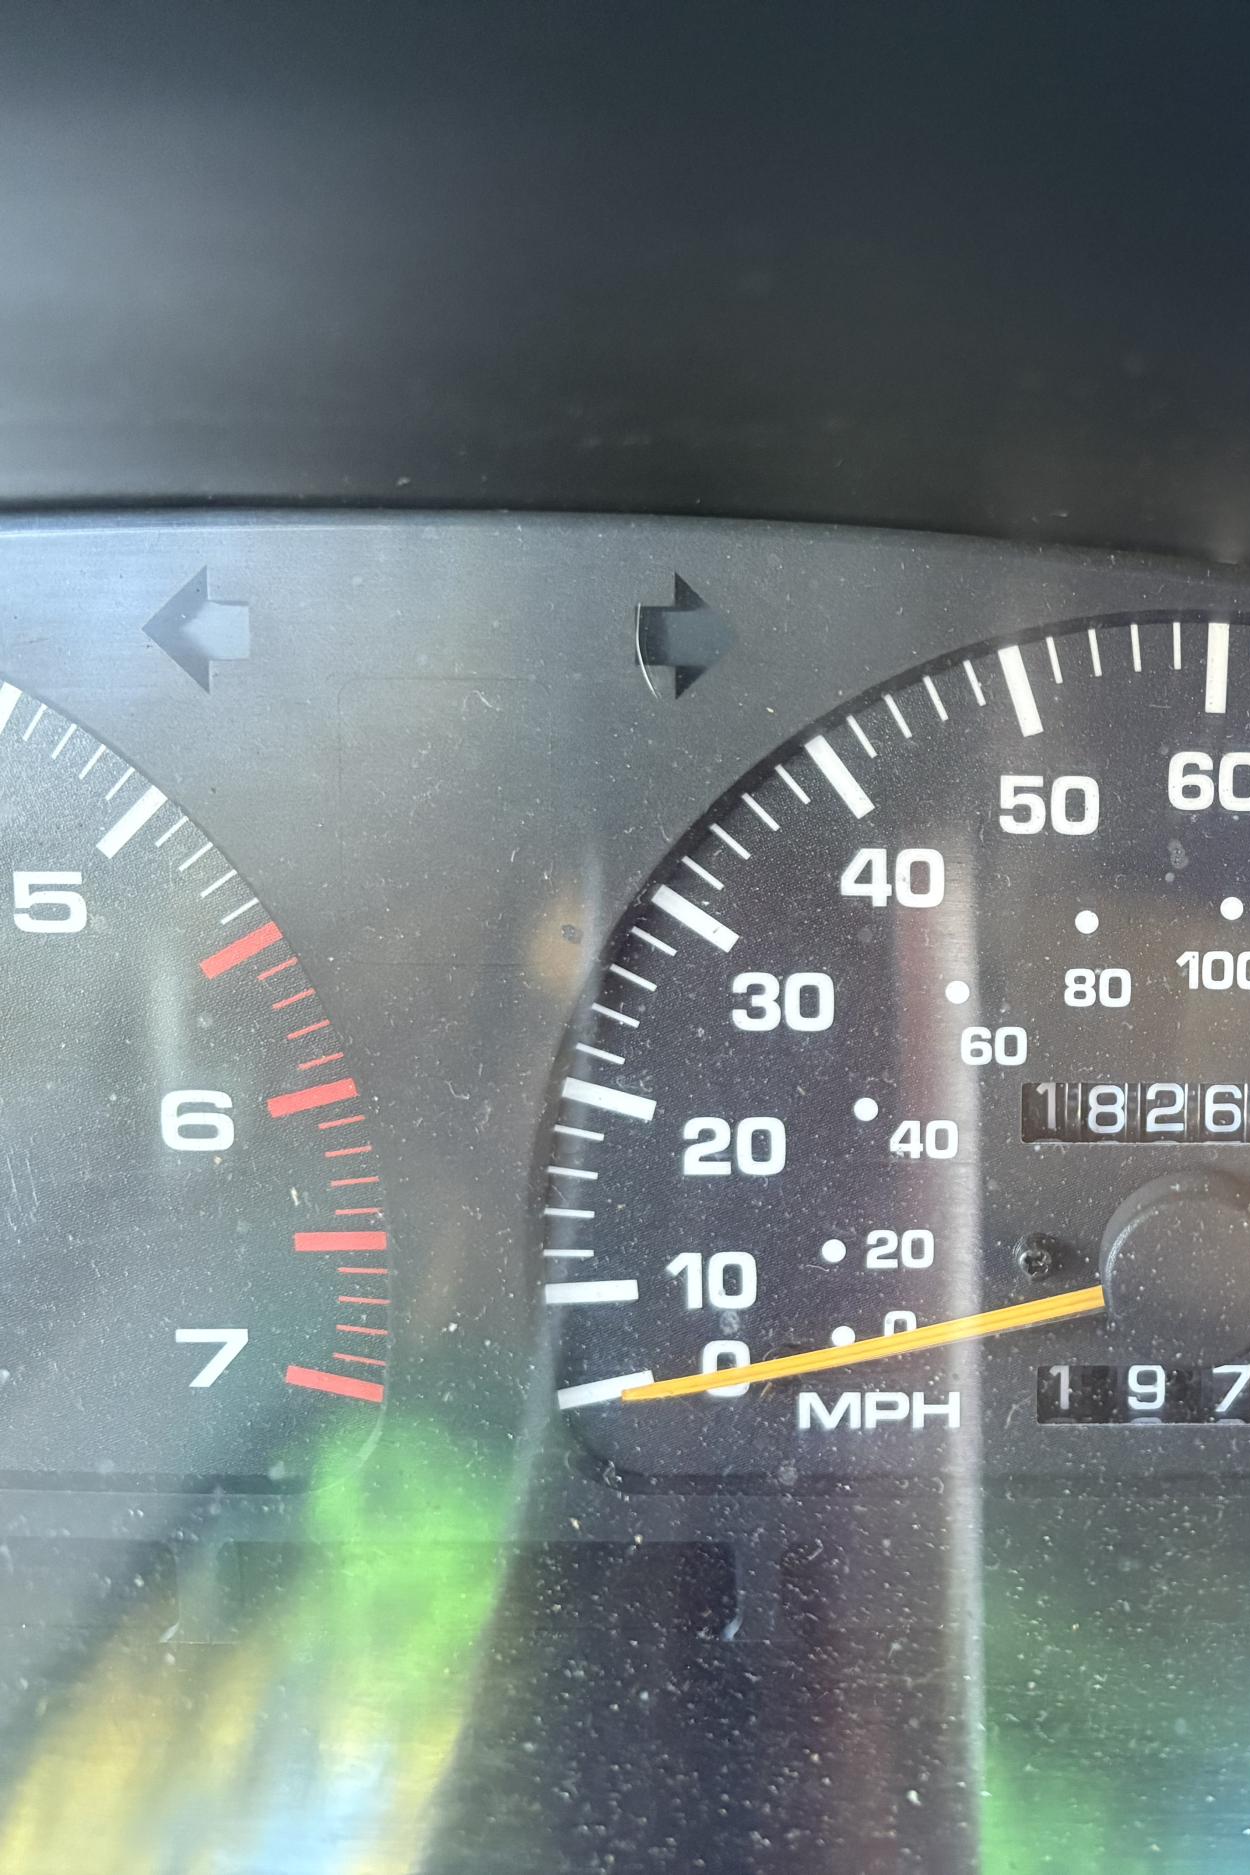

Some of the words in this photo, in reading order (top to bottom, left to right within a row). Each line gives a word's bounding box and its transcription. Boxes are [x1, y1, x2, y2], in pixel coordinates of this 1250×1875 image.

[1000, 775, 1100, 836] 50
[13, 871, 88, 934] 5
[841, 848, 946, 908] 40
[731, 972, 835, 1032] 30
[1064, 968, 1132, 1008] 80
[960, 1026, 1028, 1066] 60
[161, 1090, 235, 1152] 6
[683, 1116, 787, 1176] 20
[889, 1120, 958, 1159] 40
[866, 1229, 934, 1268] 20
[666, 1251, 757, 1309] 10
[175, 1329, 248, 1388] 7
[702, 1340, 750, 1397] 0
[799, 1391, 961, 1430] MPH
